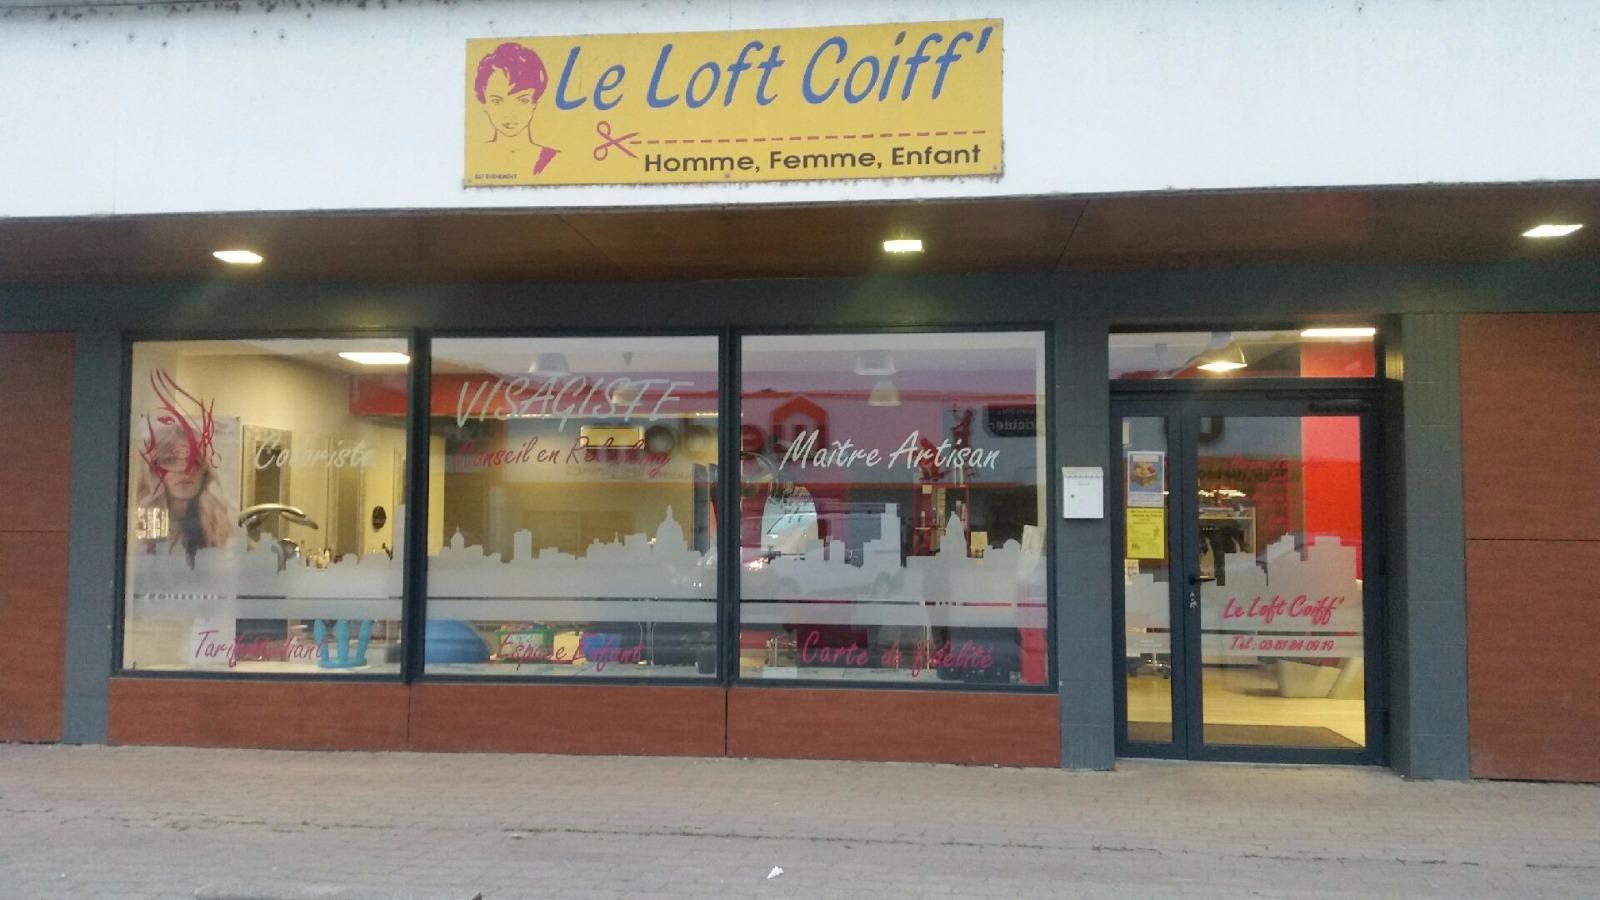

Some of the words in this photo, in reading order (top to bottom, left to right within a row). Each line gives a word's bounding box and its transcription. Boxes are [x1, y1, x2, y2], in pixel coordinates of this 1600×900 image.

[554, 46, 625, 111] Le
[646, 40, 784, 110] Loft
[802, 26, 993, 105] Coiff'
[644, 152, 760, 173] Homme,
[770, 148, 882, 171] Femme,
[891, 144, 981, 166] Enfant
[456, 375, 695, 432] VISAGISTE
[537, 446, 558, 465] en
[779, 429, 882, 471] Maître
[888, 430, 1000, 470] Artisan
[1222, 597, 1245, 619] Le
[1247, 595, 1287, 624] Loft
[497, 633, 567, 671] Espae
[802, 630, 869, 665] Carte
